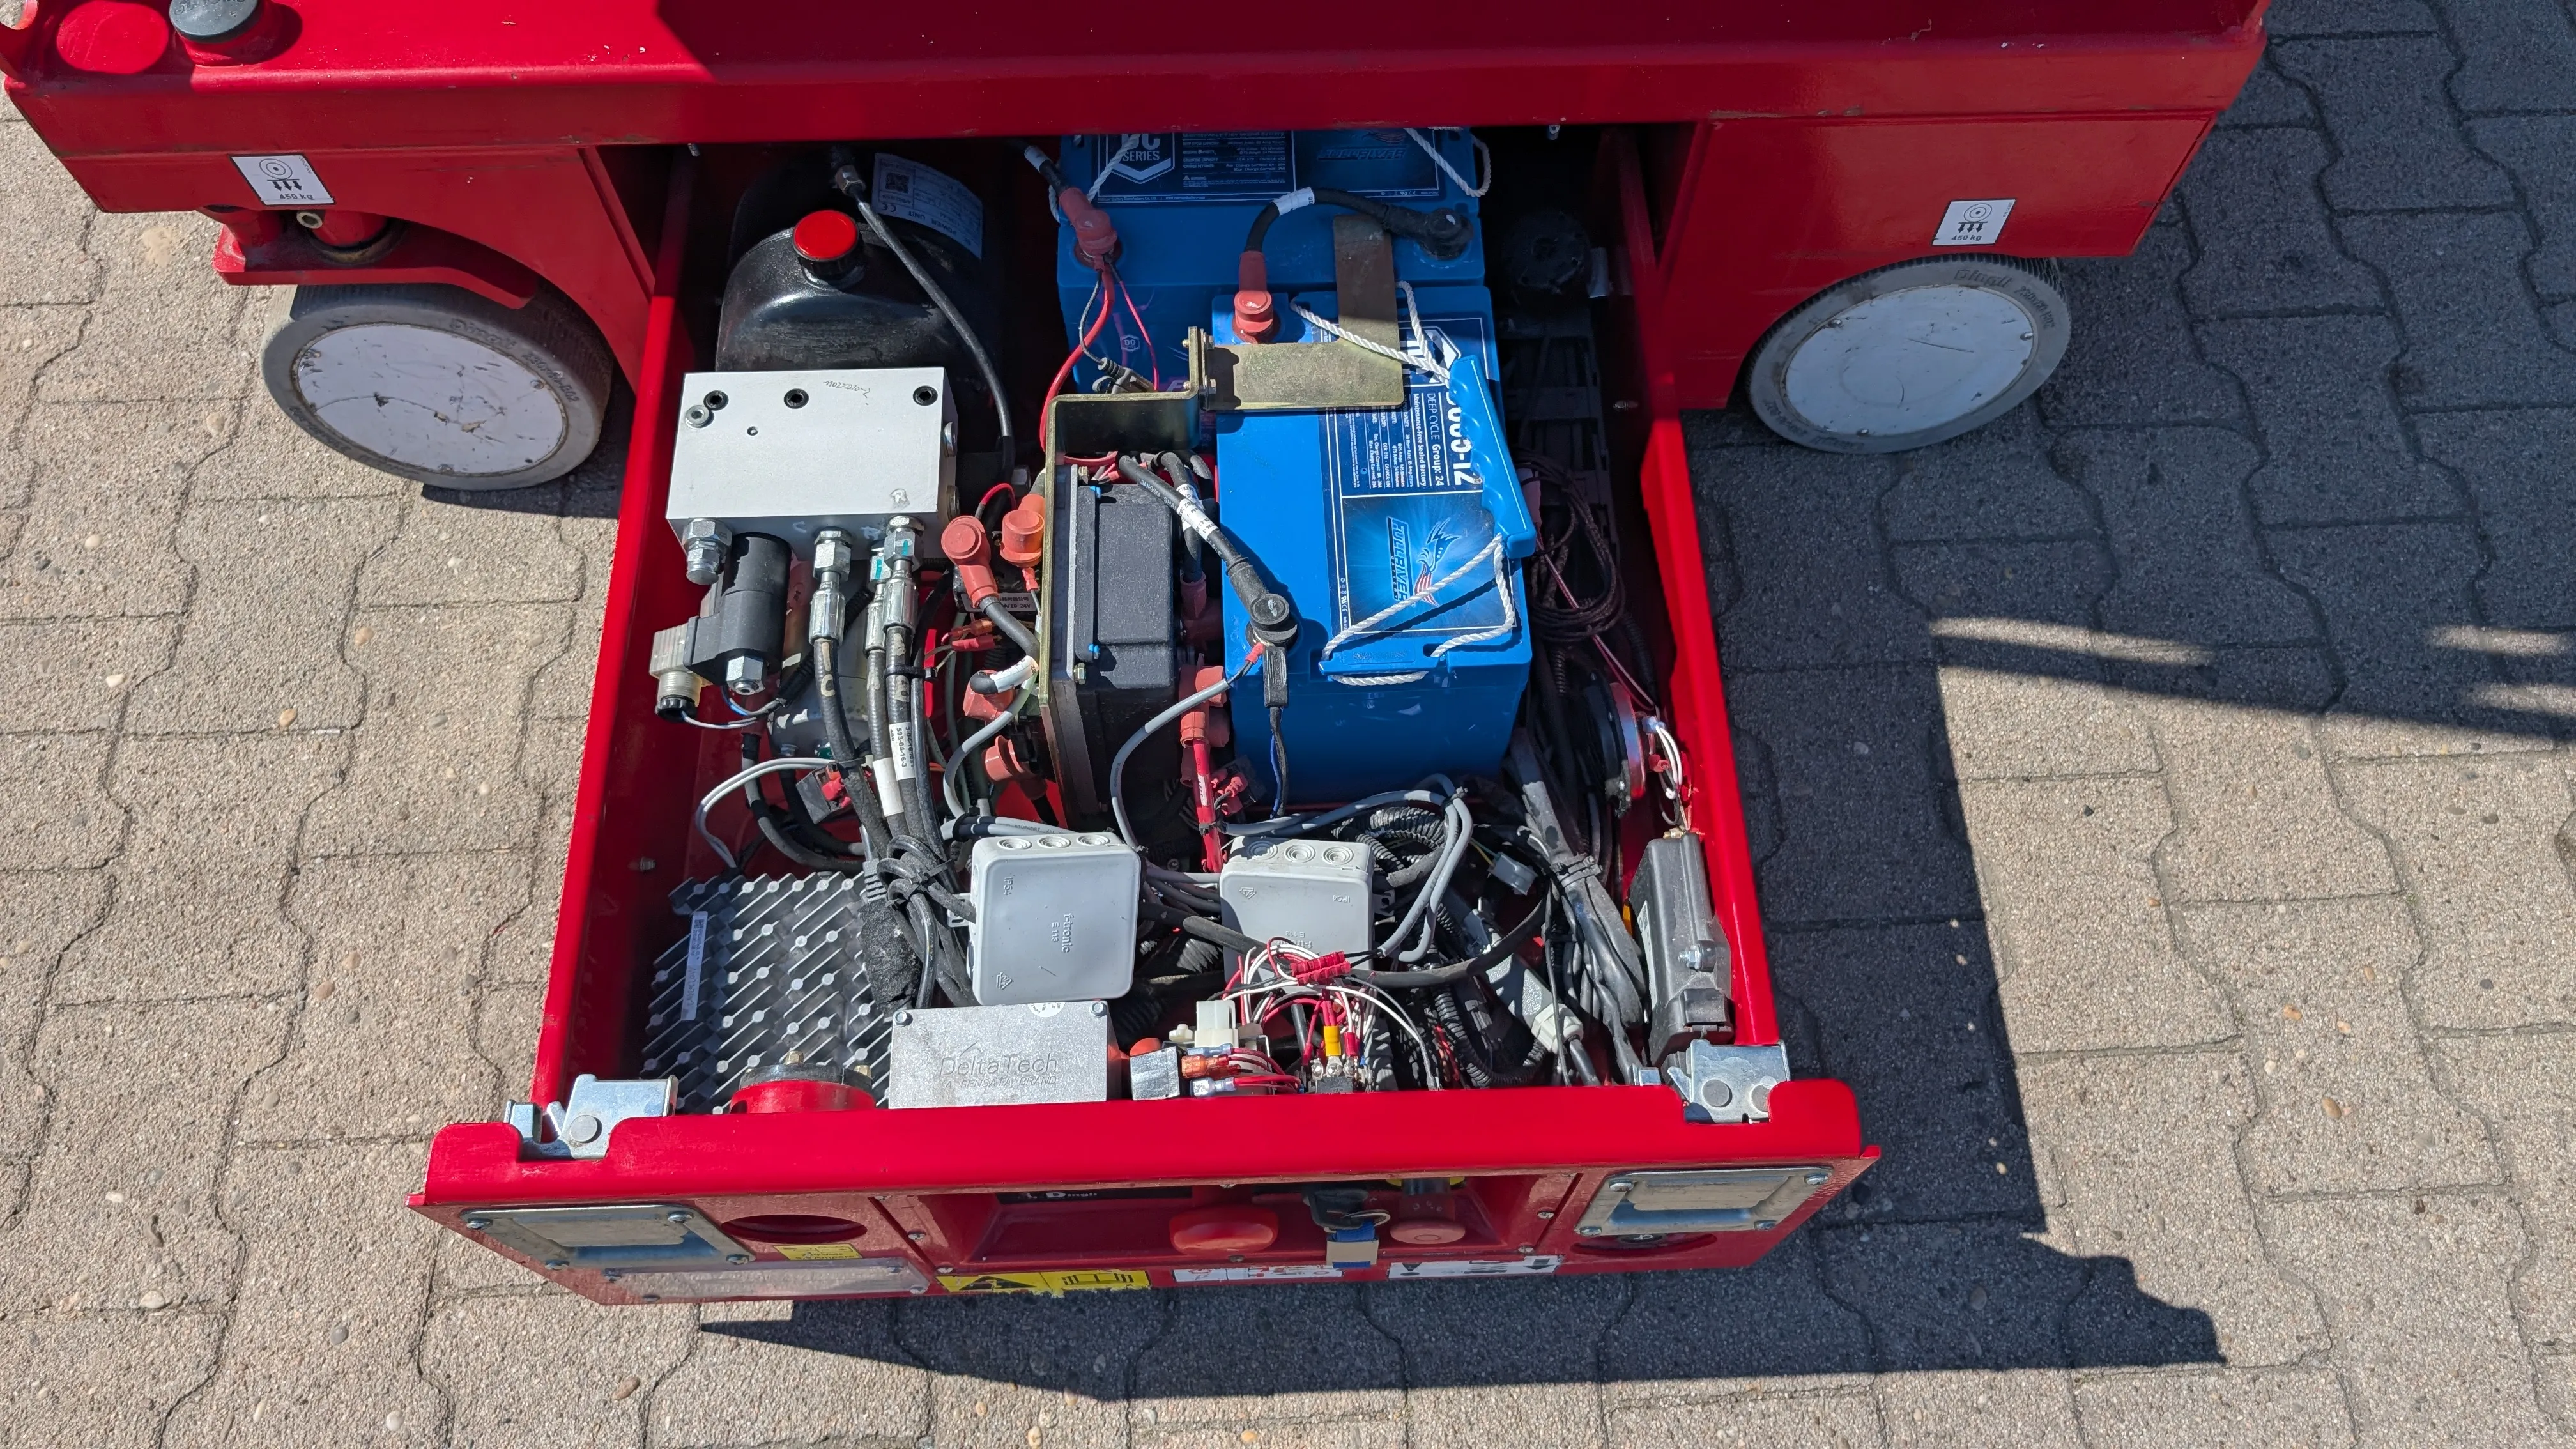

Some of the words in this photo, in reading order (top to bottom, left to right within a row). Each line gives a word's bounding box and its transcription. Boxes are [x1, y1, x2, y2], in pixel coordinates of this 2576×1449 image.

[1122, 150, 1160, 161] SERIES
[1427, 393, 1437, 413] DEEP
[1413, 393, 1423, 445] Maintenance-Free
[1418, 444, 1426, 464] Sealed
[1429, 415, 1440, 440] CYCLE
[1432, 444, 1442, 474] Group:
[1436, 475, 1444, 486] 24
[896, 727, 907, 768] 593-04-16-3
[1003, 877, 1013, 895] IP54
[1333, 894, 1351, 903] IP54
[1061, 912, 1074, 953] f-tronic
[940, 1053, 1057, 1078] DeltaTech
[961, 1078, 1011, 1087] SENSATA
[1020, 1076, 1057, 1085] BRAND
